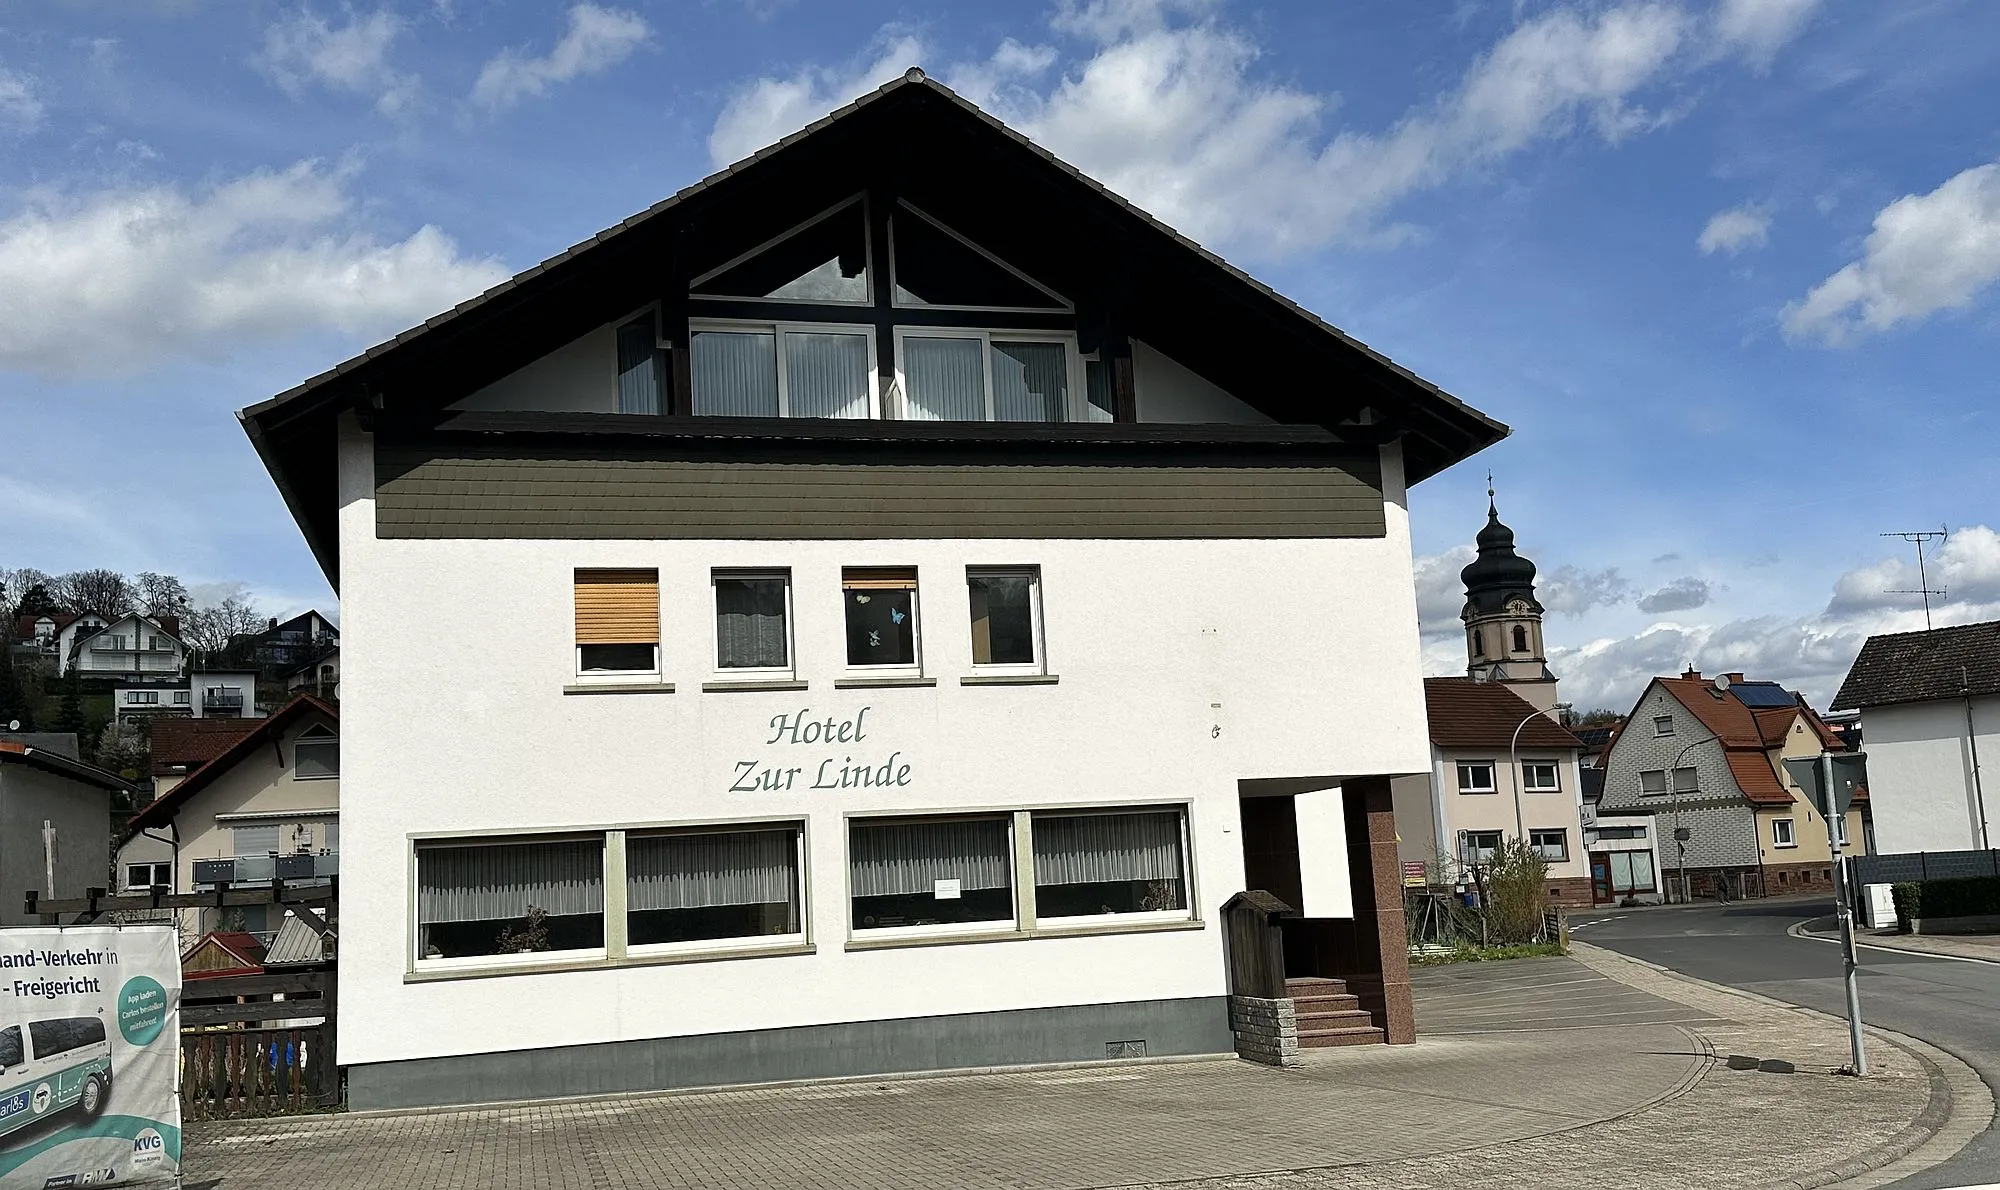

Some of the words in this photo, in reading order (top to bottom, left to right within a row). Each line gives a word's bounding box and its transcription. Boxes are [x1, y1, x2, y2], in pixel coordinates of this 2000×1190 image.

[766, 706, 871, 745] Hotel
[728, 760, 802, 793] Zur
[809, 751, 912, 790] Linde
[105, 947, 119, 965] in
[13, 975, 101, 1000] Freigericht
[133, 1135, 161, 1152] KVG
